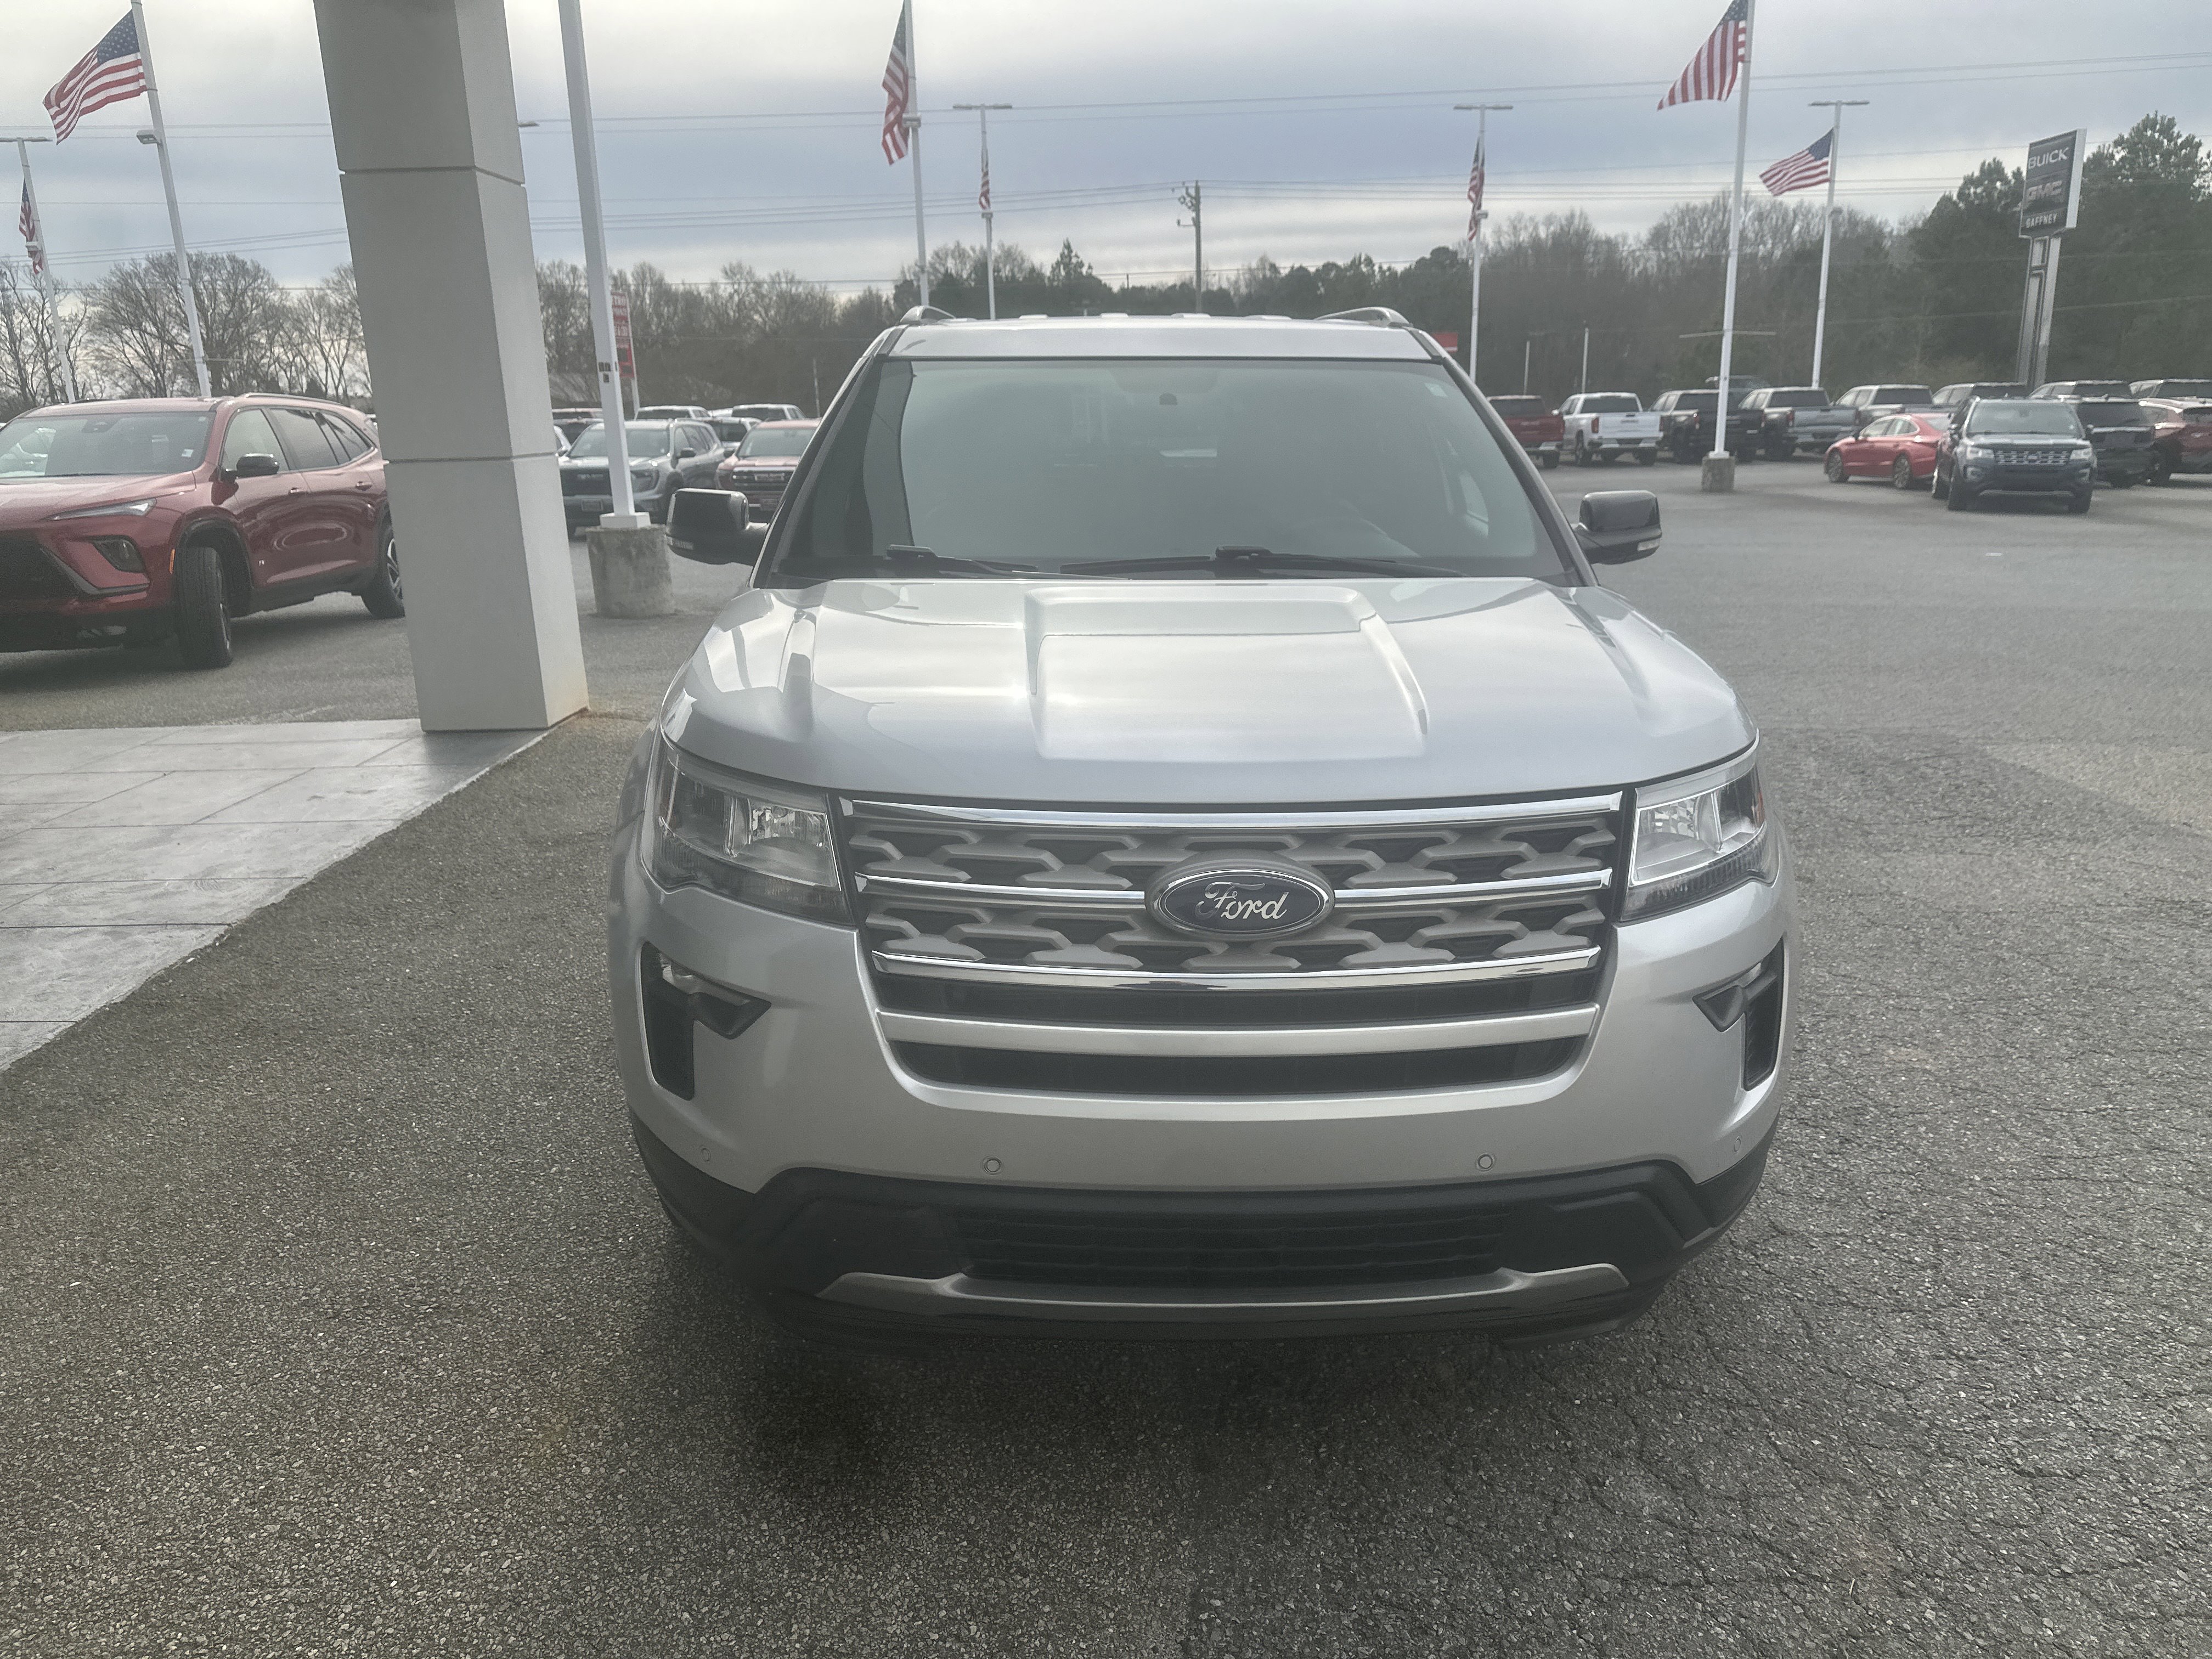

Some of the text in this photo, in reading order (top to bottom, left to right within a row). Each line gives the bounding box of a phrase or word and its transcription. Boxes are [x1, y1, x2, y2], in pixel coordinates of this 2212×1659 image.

[2028, 147, 2069, 170] BUICK
[2027, 180, 2062, 201] GMC
[1194, 881, 1289, 920] Ford
